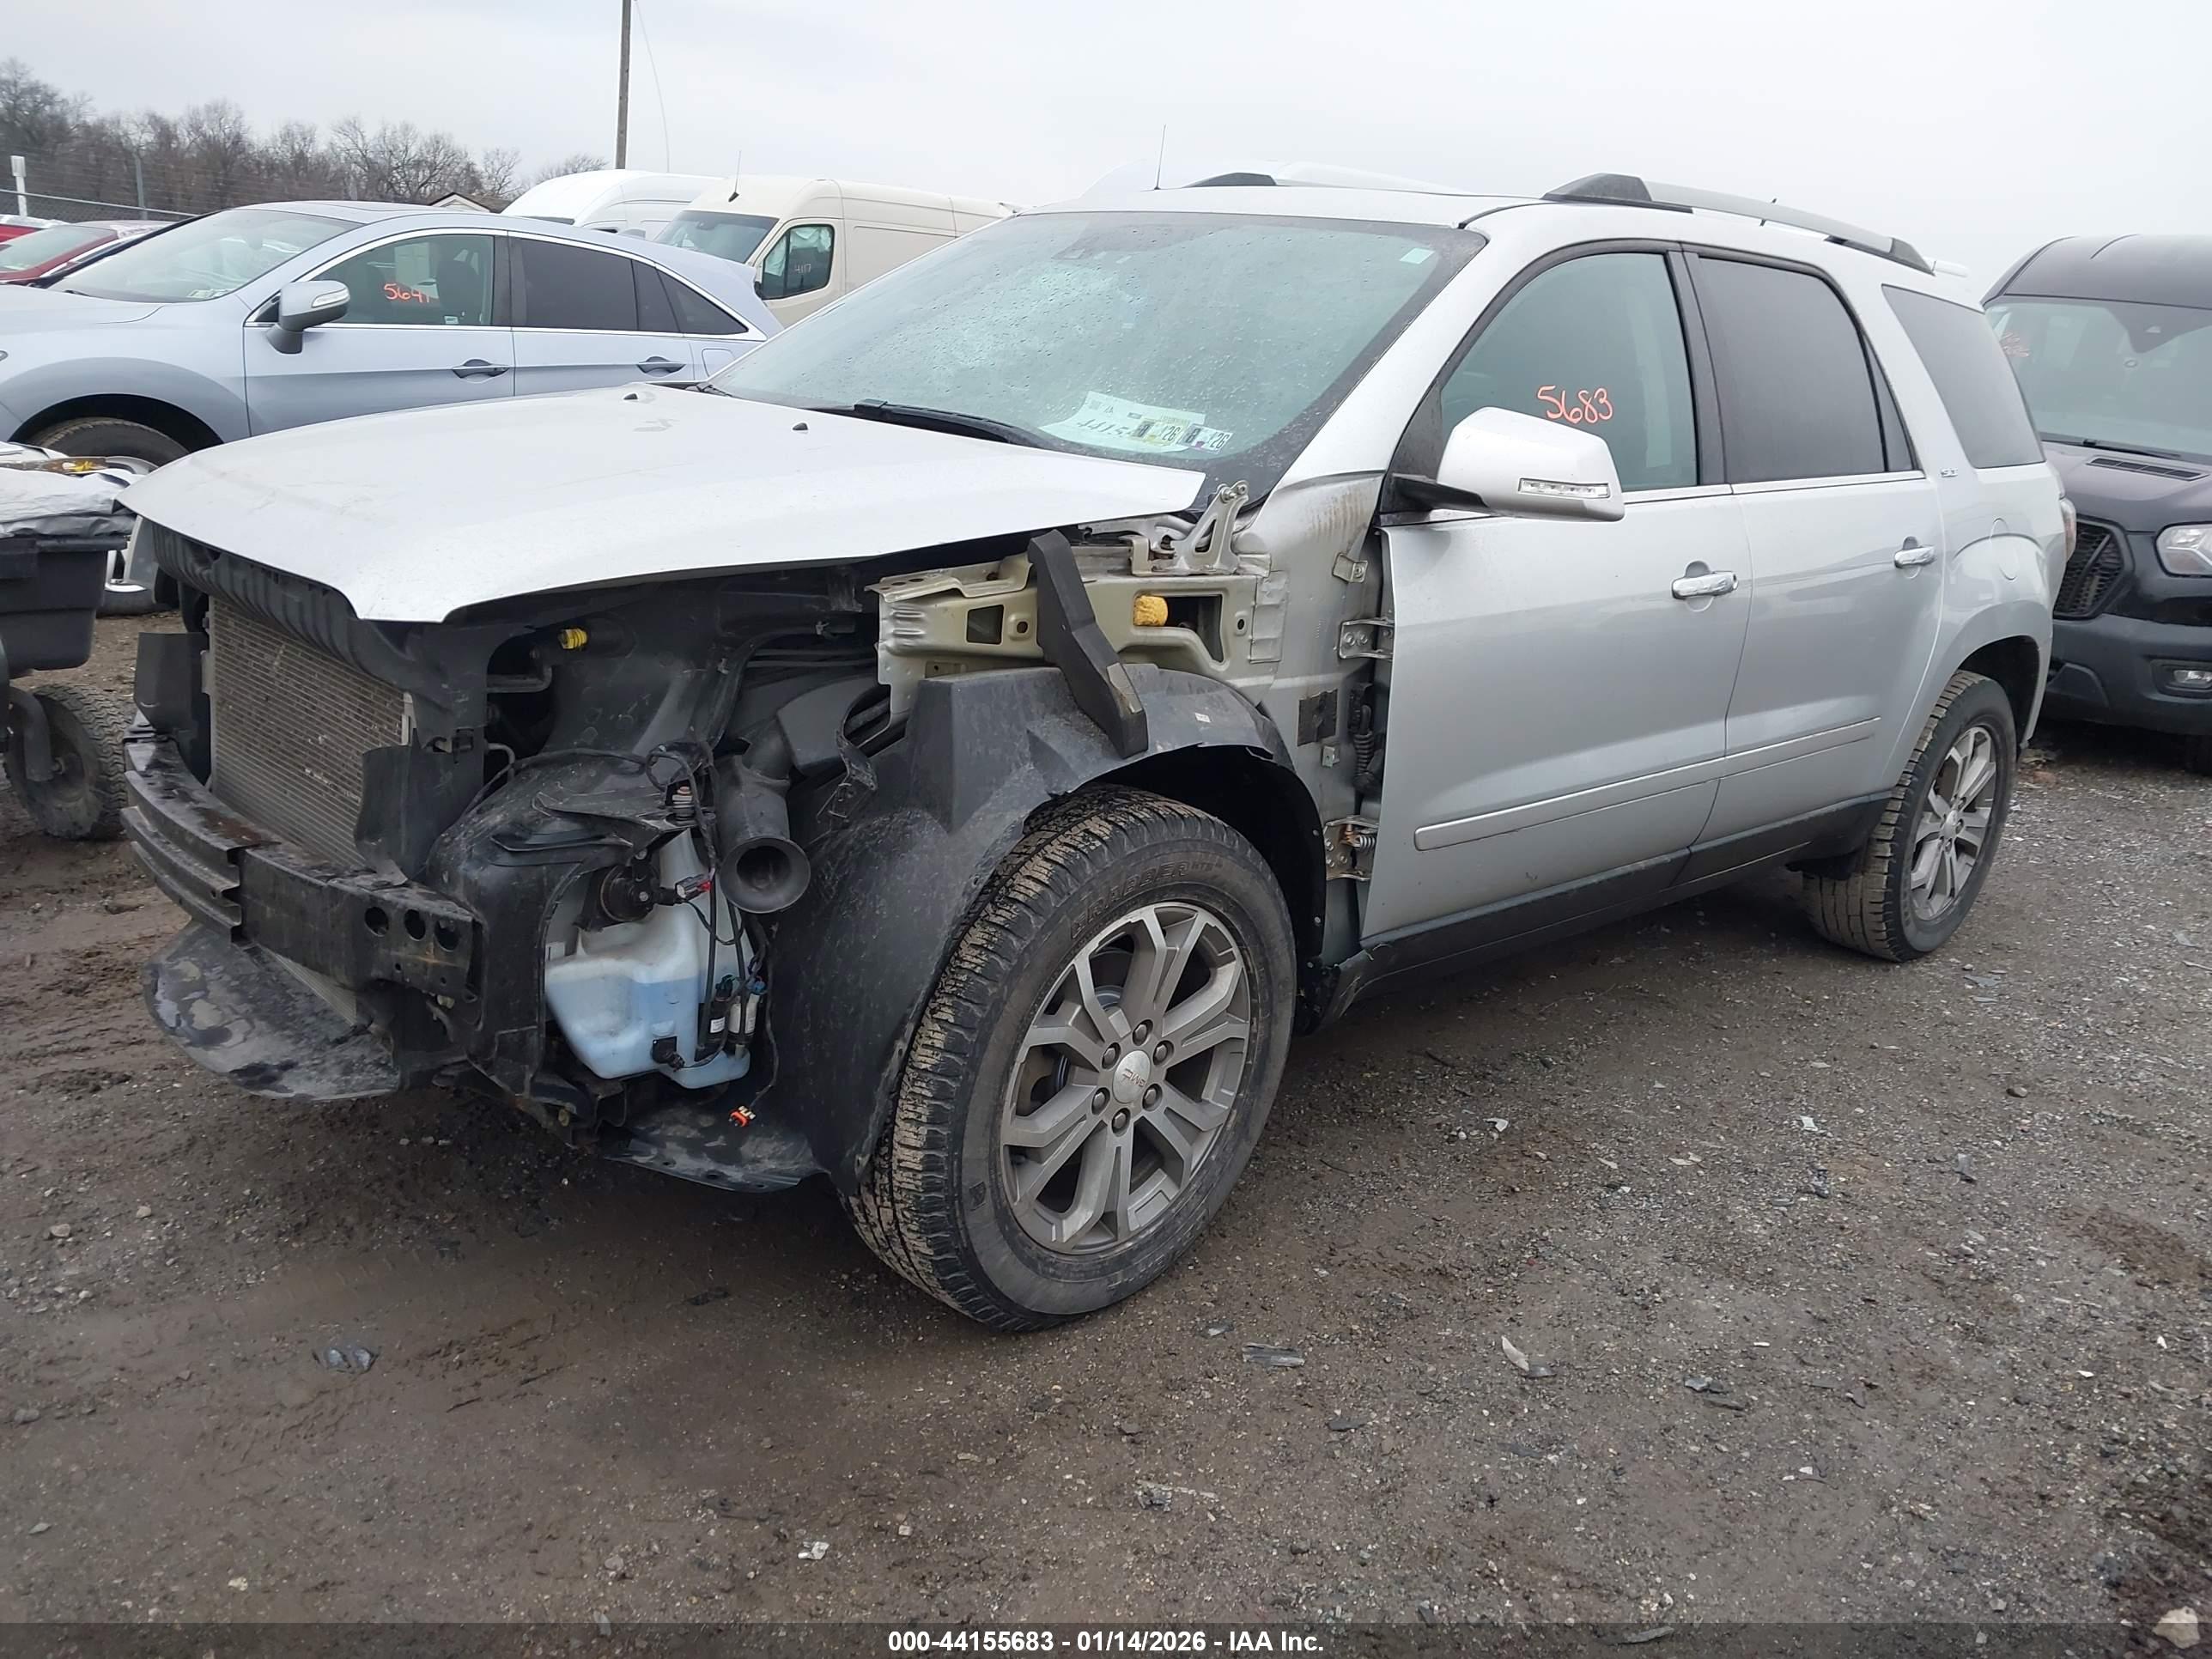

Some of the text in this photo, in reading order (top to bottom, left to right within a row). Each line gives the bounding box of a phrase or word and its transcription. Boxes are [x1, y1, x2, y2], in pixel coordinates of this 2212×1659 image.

[1537, 385, 1613, 424] 5683
[1077, 418, 1132, 438] 4415
[1122, 1067, 1146, 1088] GMC
